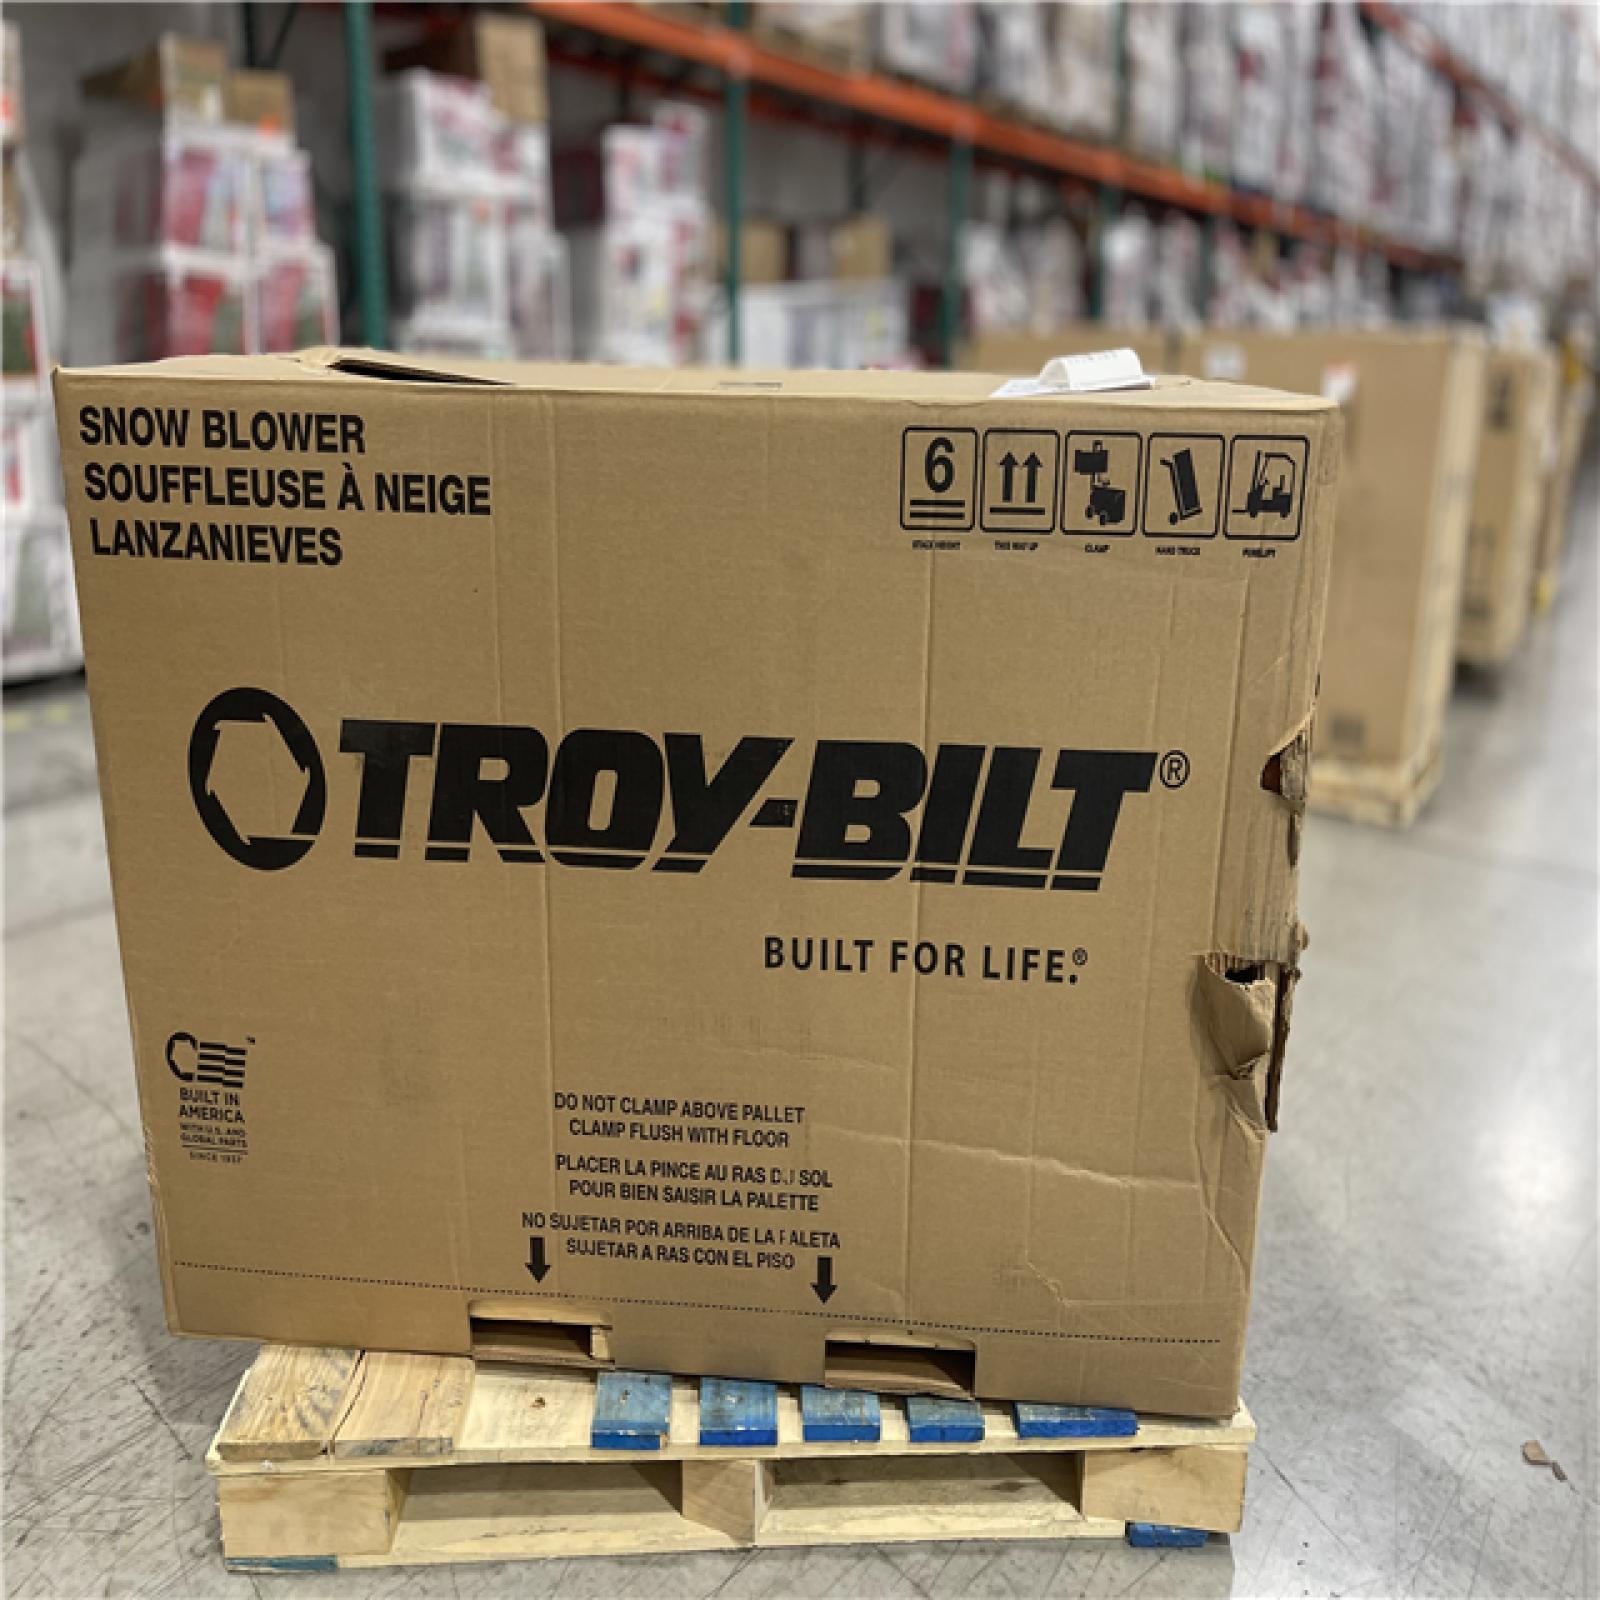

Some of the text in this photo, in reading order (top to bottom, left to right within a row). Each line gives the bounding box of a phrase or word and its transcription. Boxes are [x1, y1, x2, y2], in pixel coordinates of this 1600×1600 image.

[80, 405, 365, 455] SNOW BLOWER
[925, 437, 955, 493] 6
[83, 462, 492, 515] SOUFFLEUSE À NEIGE
[90, 517, 343, 567] LANZANIEVES
[765, 936, 874, 973] BUILT
[890, 940, 965, 978] FOR
[180, 1087, 240, 1106] BUILT IN
[554, 1092, 805, 1124] DO NOT CLAMP ABOVE PALLET
[179, 1105, 245, 1124] AMERICA
[180, 1132, 217, 1144] GLOBAL
[570, 1118, 790, 1148] CLAMP FLUSH WITH FLOOR
[556, 1153, 620, 1175] PLACER
[625, 1158, 647, 1176] LA
[650, 1160, 700, 1180] PINCE
[704, 1165, 728, 1182] AU
[732, 1165, 767, 1185] RAS
[799, 1170, 833, 1188] SOL
[570, 1180, 819, 1213] POUR BIEN SAISIR LA PALETTE
[522, 1212, 545, 1229] NO
[550, 1212, 620, 1235] SUJETAR
[625, 1219, 660, 1237] POR
[662, 1222, 725, 1242] ARRIBA
[727, 1226, 750, 1243] DE
[755, 1227, 775, 1245] LA
[566, 1237, 795, 1270] SUJETAR A RAS CON EL PISO
